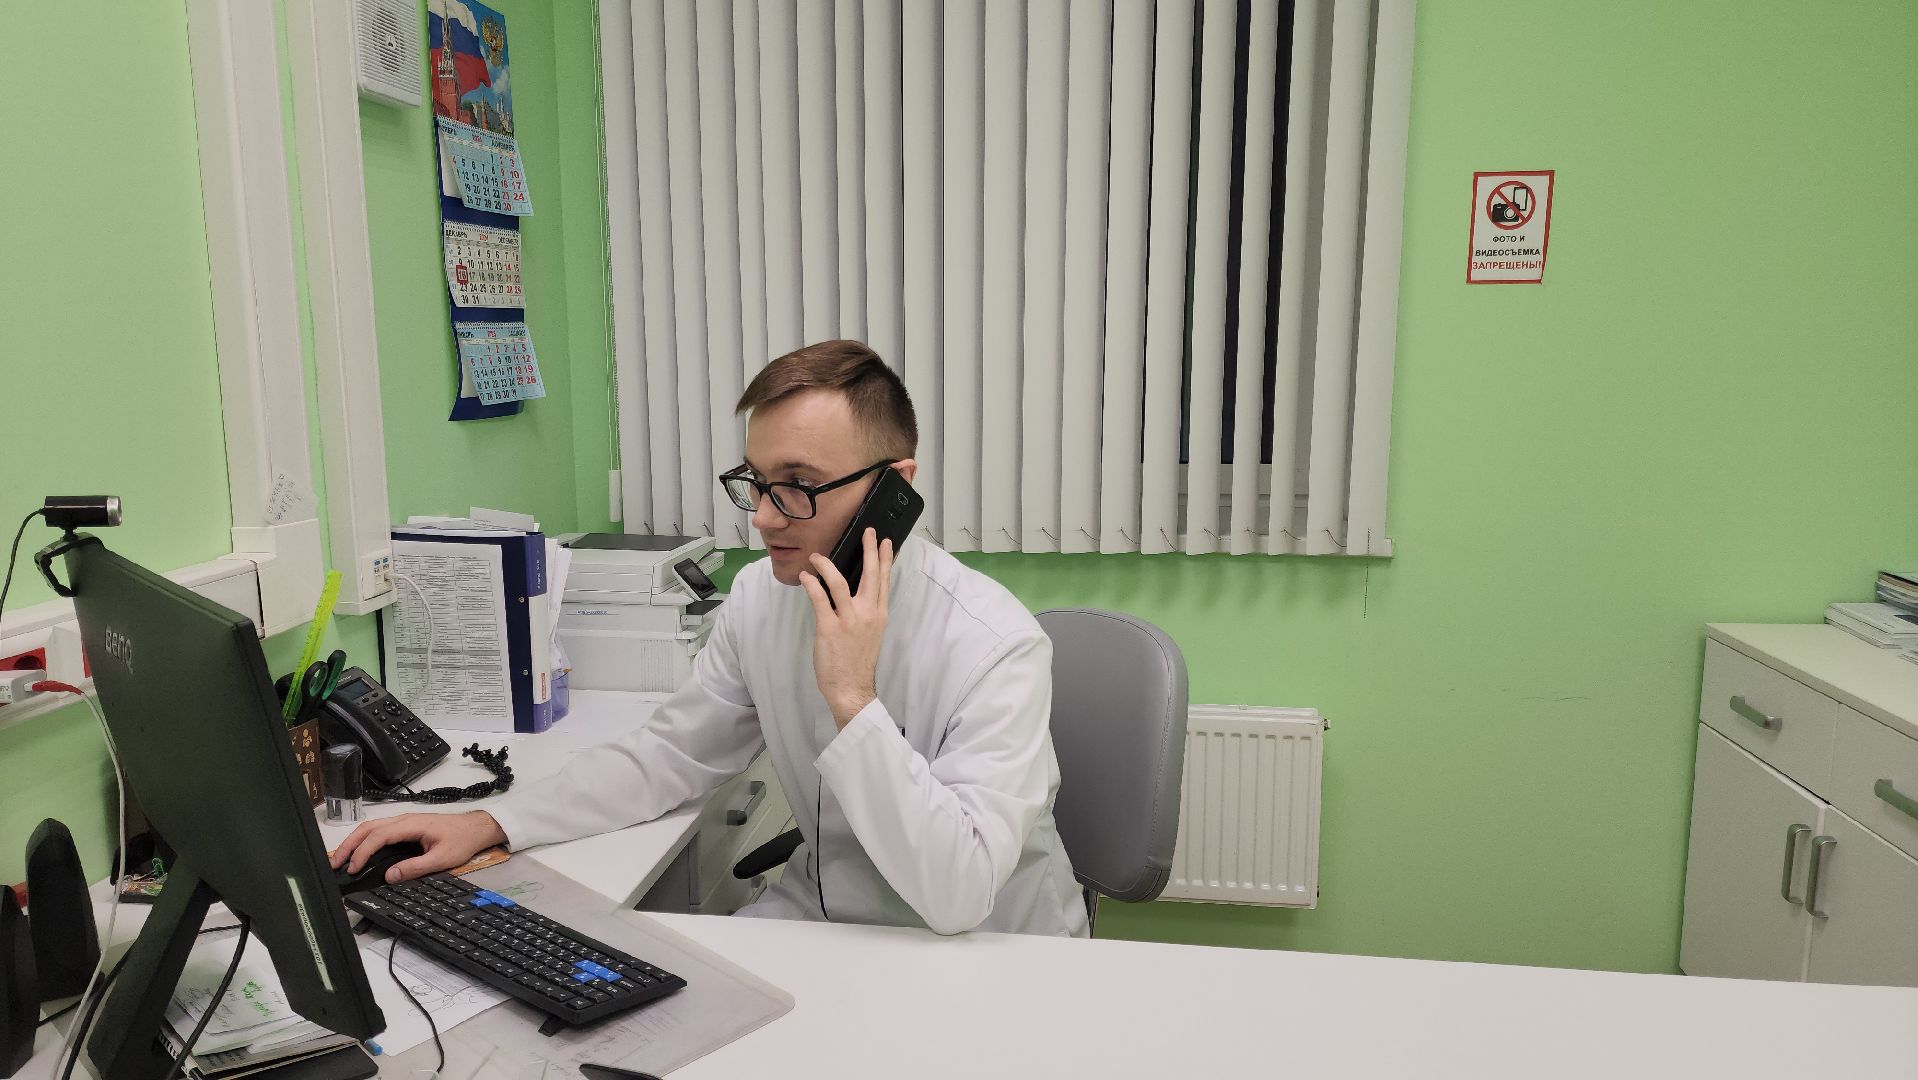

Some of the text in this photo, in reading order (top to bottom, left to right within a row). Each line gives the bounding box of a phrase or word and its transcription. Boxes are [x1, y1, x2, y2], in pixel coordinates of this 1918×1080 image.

[462, 158, 465, 167] 5
[472, 161, 476, 170] 6
[482, 164, 485, 172] 7
[510, 170, 519, 179] 10
[462, 170, 469, 180] 12
[472, 173, 479, 182] 13
[481, 176, 488, 185] 14
[491, 178, 498, 187] 15
[501, 180, 508, 188] 16
[512, 182, 521, 190] 17
[473, 185, 480, 194] 20
[483, 187, 490, 196] 21
[493, 190, 500, 198] 22
[502, 192, 509, 200] 23
[514, 193, 524, 201] 24
[484, 199, 492, 208] 28
[494, 201, 501, 210] 29
[503, 203, 512, 211] 30
[457, 246, 461, 255] 2
[467, 247, 471, 257] 3
[486, 250, 490, 258] 5
[495, 250, 499, 259] 6
[1475, 249, 1540, 257] ВИДЕОСЪЕМКА
[467, 260, 474, 269] 10
[478, 261, 483, 270] 11
[487, 262, 493, 270] 12
[496, 262, 502, 271] 13
[504, 263, 511, 271] 14
[1473, 261, 1542, 270] ЗАПРЕЩЕНЫ!
[459, 270, 466, 279] 16
[469, 272, 475, 280] 17
[488, 273, 494, 282] 19
[497, 273, 503, 282] 20
[460, 284, 467, 292] 23
[470, 283, 477, 292] 24
[480, 284, 486, 293] 25
[489, 285, 496, 293] 26
[462, 295, 469, 304] 30
[472, 295, 480, 304] 31
[512, 344, 516, 352] 4
[521, 344, 526, 352] 5
[497, 356, 501, 364] 9
[505, 355, 511, 364] 10
[513, 355, 519, 364] 11
[481, 369, 487, 377] 14
[490, 368, 496, 377] 15
[498, 367, 504, 376] 16
[507, 367, 513, 375] 17
[515, 365, 521, 374] 18
[524, 364, 533, 373] 19
[484, 380, 490, 389] 21
[492, 379, 499, 388] 22
[500, 379, 507, 387] 23
[509, 378, 514, 386] 24
[526, 376, 536, 384] 26
[486, 392, 493, 400] 28
[495, 391, 501, 399] 29
[502, 390, 510, 398] 30
[511, 389, 516, 397] 31
[105, 625, 133, 674] BenQ
